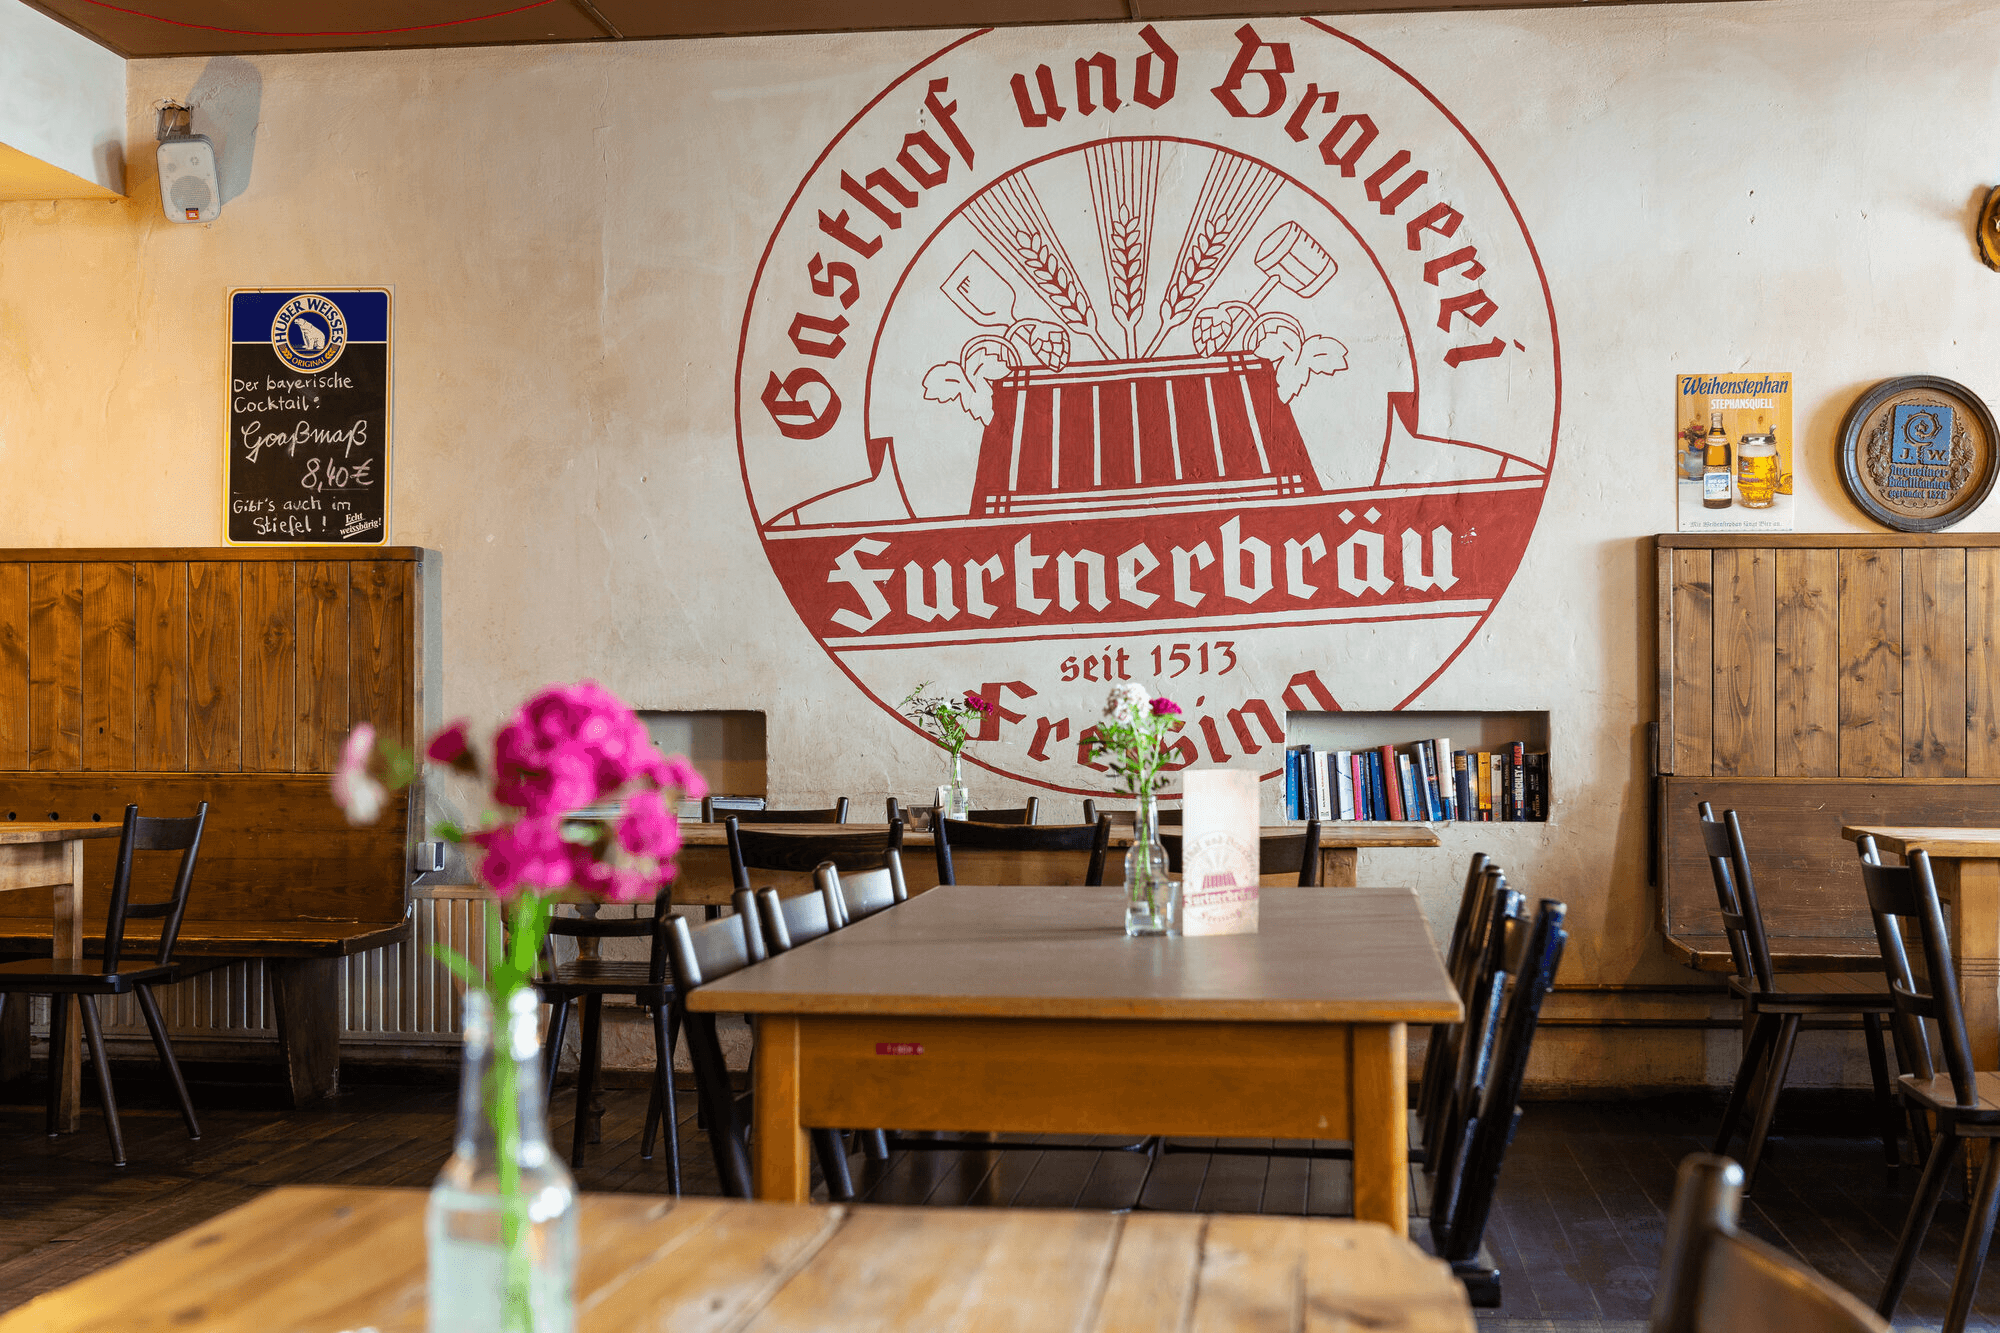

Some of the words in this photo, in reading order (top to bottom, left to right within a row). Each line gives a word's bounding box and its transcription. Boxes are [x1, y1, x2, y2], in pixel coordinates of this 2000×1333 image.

[761, 77, 977, 441] Gasthof
[1010, 24, 1180, 128] und
[1210, 22, 1526, 369] Brauerei
[275, 300, 306, 343] HUBER
[307, 298, 344, 344] WEISSES
[291, 357, 327, 367] ORIGINAL
[233, 379, 259, 392] Der
[266, 371, 354, 394] bayerische
[1681, 375, 1789, 397] Weihenstephan
[1710, 398, 1775, 410] STEPHANSQUELL
[1890, 464, 1949, 478] Augustiner
[283, 495, 322, 511] auch
[331, 496, 351, 511] im
[253, 514, 312, 537] Stiefel
[827, 505, 1461, 635] Furtnerbräu
[1060, 645, 1132, 682] seit
[1150, 641, 1238, 679] 1513
[950, 669, 1342, 772] Fresin
